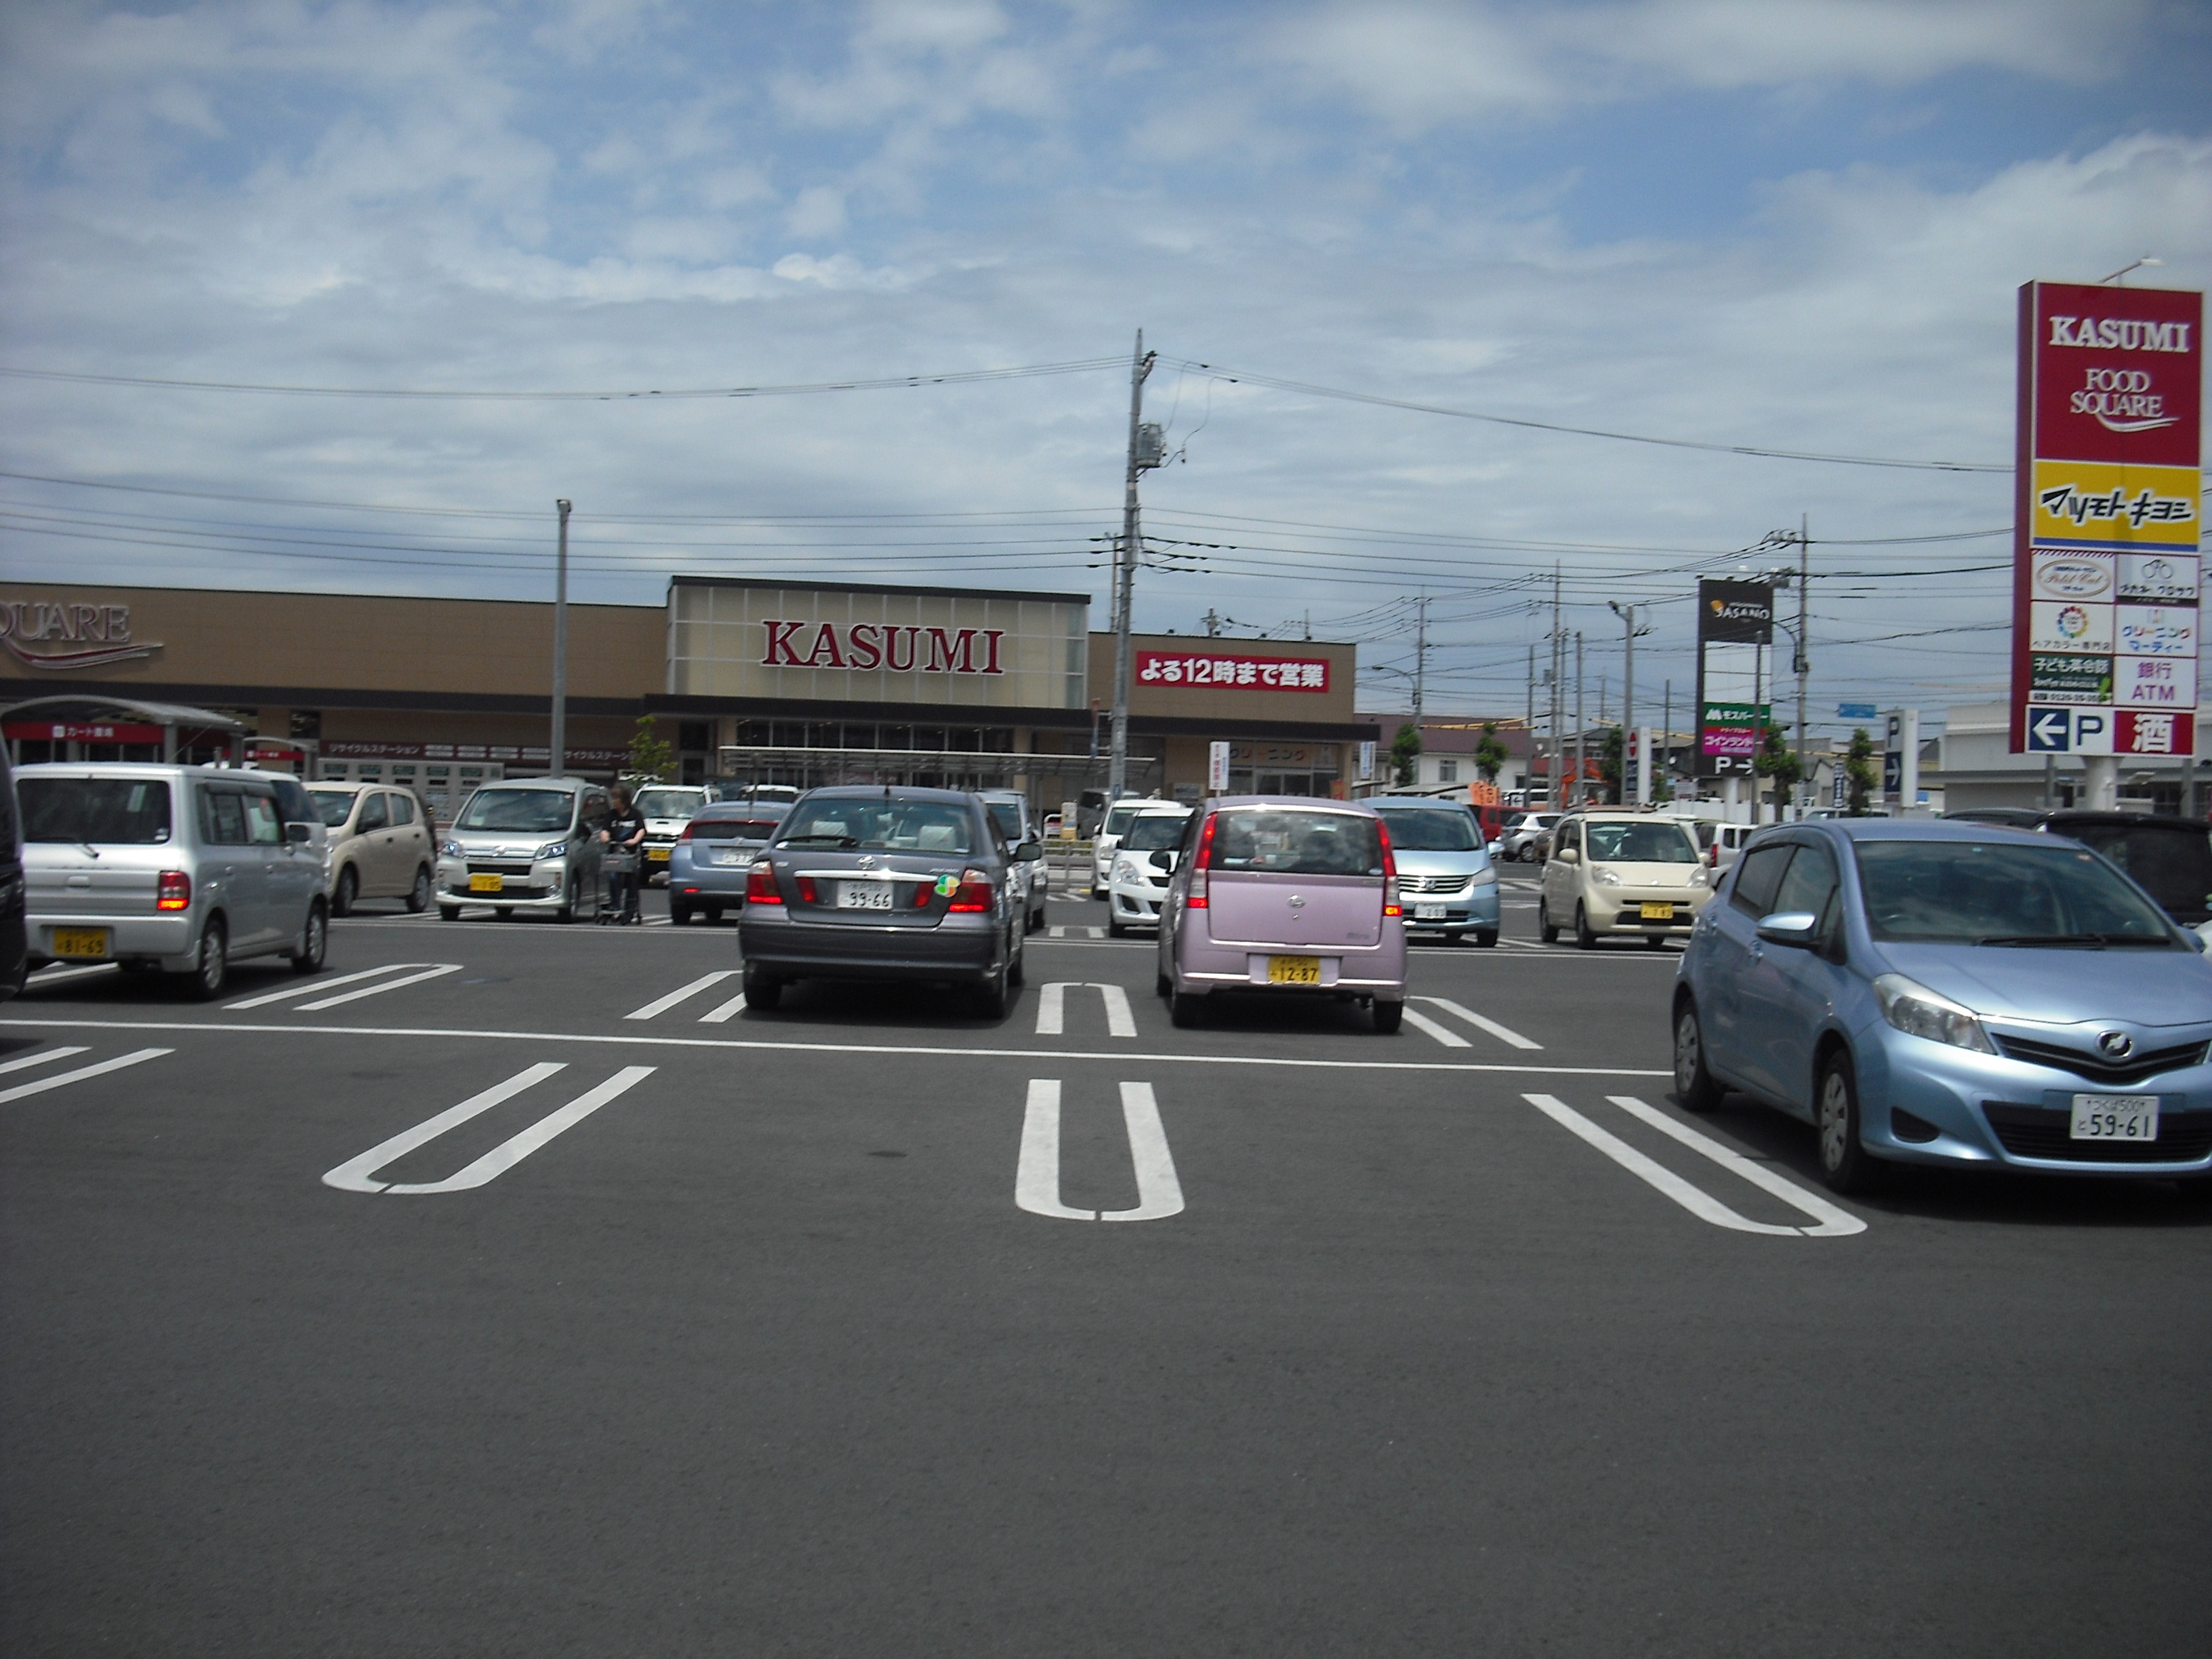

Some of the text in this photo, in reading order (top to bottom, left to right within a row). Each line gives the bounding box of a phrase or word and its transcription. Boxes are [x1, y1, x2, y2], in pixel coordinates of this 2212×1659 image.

[2049, 316, 2190, 352] KASUMI
[2085, 368, 2152, 393] FOOD
[2070, 391, 2171, 426] SQUARE
[760, 619, 1006, 675] KASUMI
[1140, 658, 1325, 688] よる12時まで営業
[2137, 661, 2173, 680] 銀行
[2131, 685, 2175, 701] ATM
[1722, 710, 1769, 720] モスバーー
[1889, 716, 1900, 748] P
[2076, 716, 2103, 746] P
[2131, 713, 2175, 753] 酒
[329, 743, 420, 755] リサイクルステーション
[1715, 756, 1732, 775] P
[849, 892, 889, 907] 99-66
[2090, 1114, 2150, 1136] 59-61
